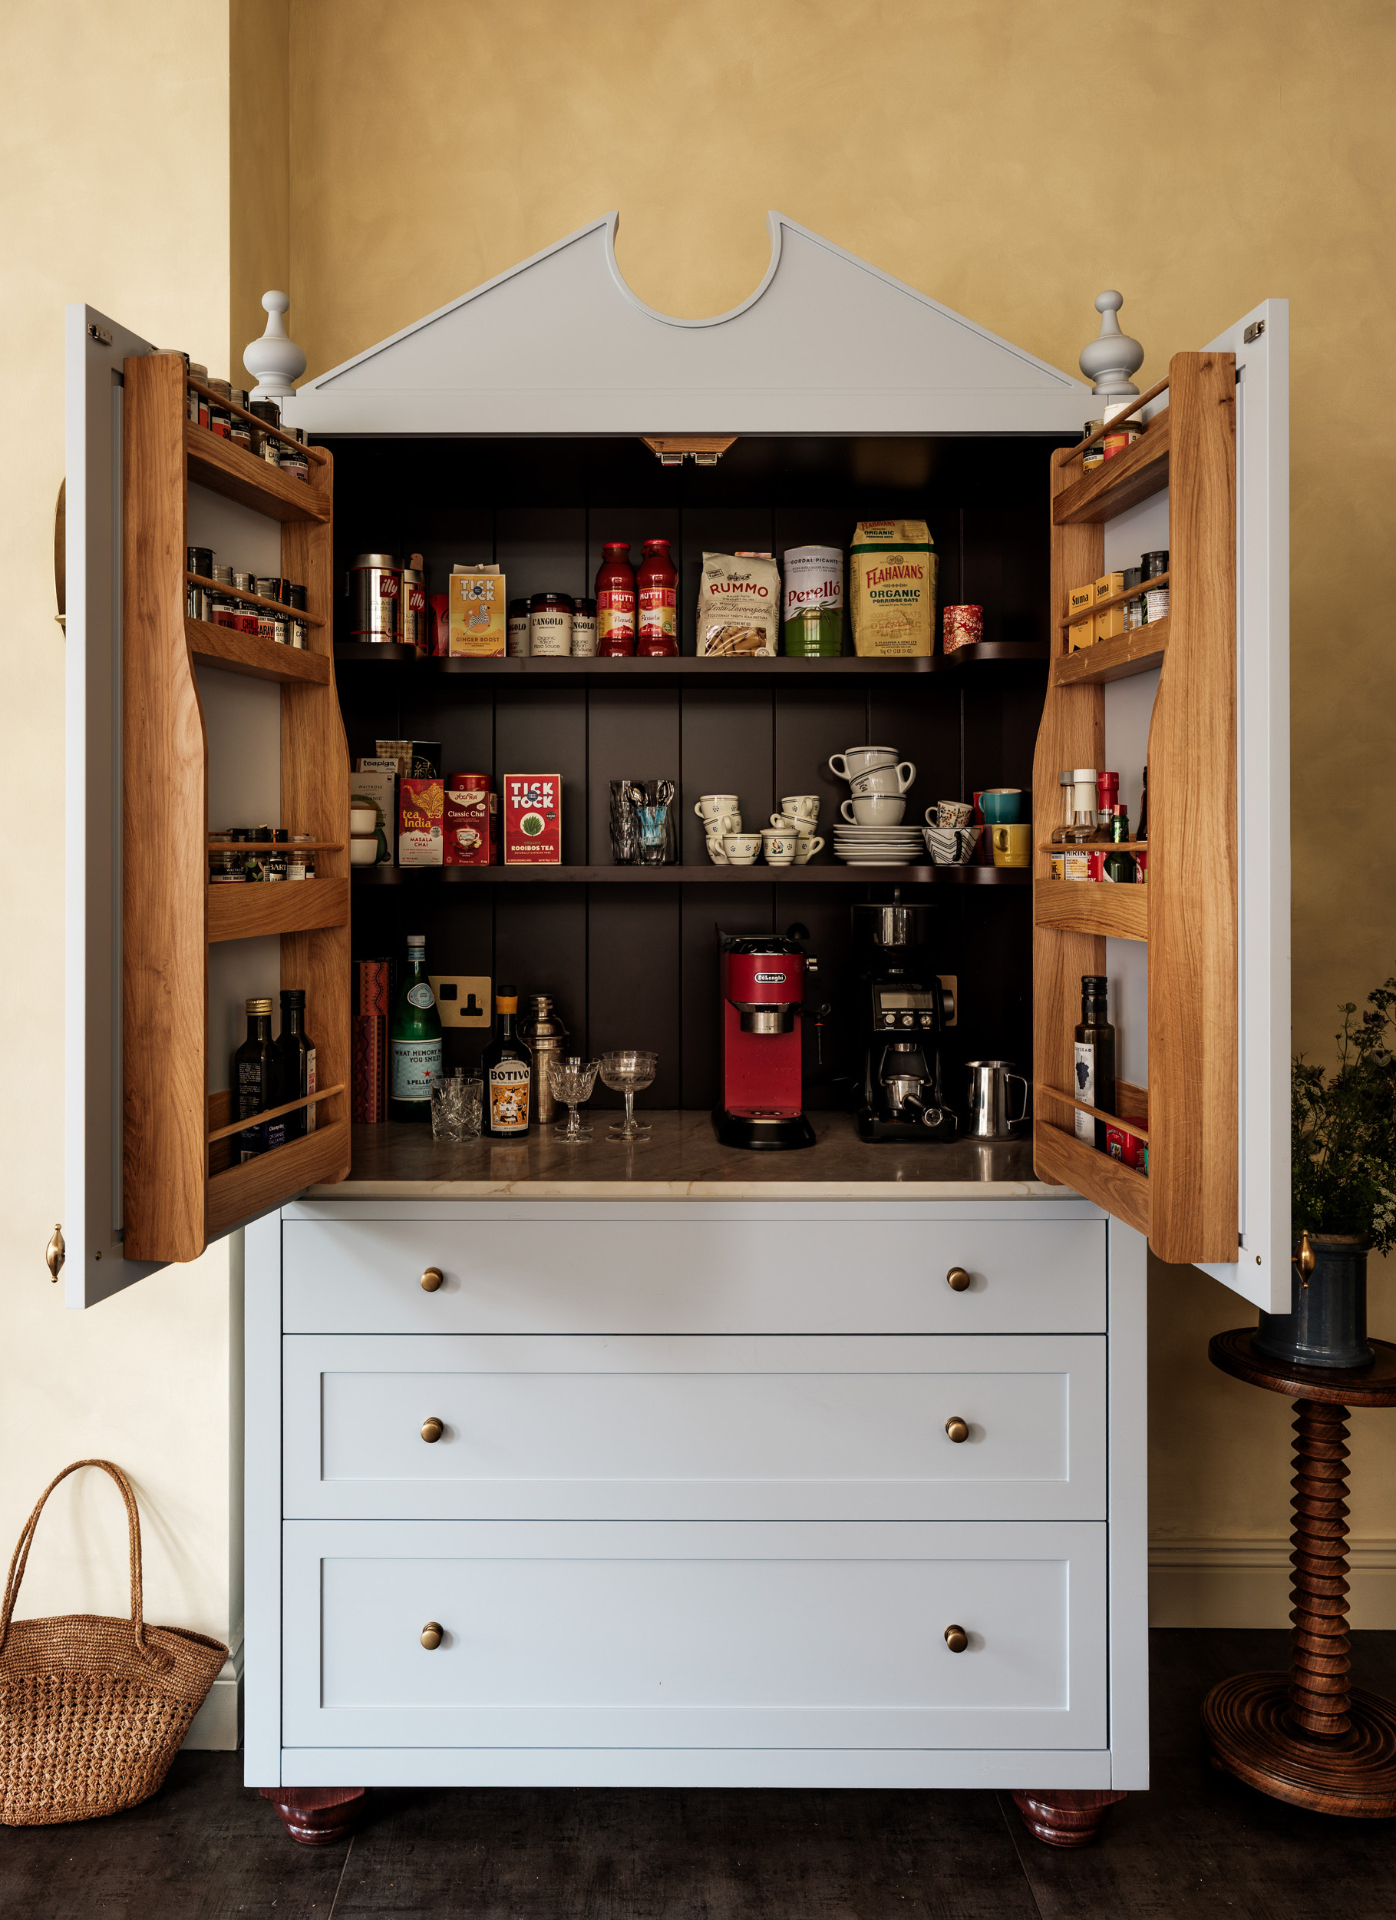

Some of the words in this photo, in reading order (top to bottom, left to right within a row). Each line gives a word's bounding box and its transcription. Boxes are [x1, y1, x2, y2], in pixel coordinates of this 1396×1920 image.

[866, 564, 924, 589] FLAHAVAN'S
[381, 578, 398, 597] illy
[460, 579, 495, 590] TICK
[709, 583, 769, 597] RUMMO
[1097, 583, 1109, 596] Suma
[460, 590, 495, 601] TOCK
[640, 591, 662, 600] MUTTI
[788, 580, 841, 607] Perelló
[869, 589, 921, 599] ORGANIC
[409, 593, 425, 610] illy
[1072, 593, 1089, 606] Suma
[532, 617, 563, 627] L'ANGOLO
[572, 621, 595, 630] NGOLO
[511, 782, 554, 795] TICK
[511, 796, 554, 809] TOCK
[403, 809, 419, 819] tea
[470, 810, 485, 818] Chai
[404, 818, 432, 828] India
[412, 1049, 437, 1057] MEMORY
[490, 1070, 529, 1081] BOTIVO
